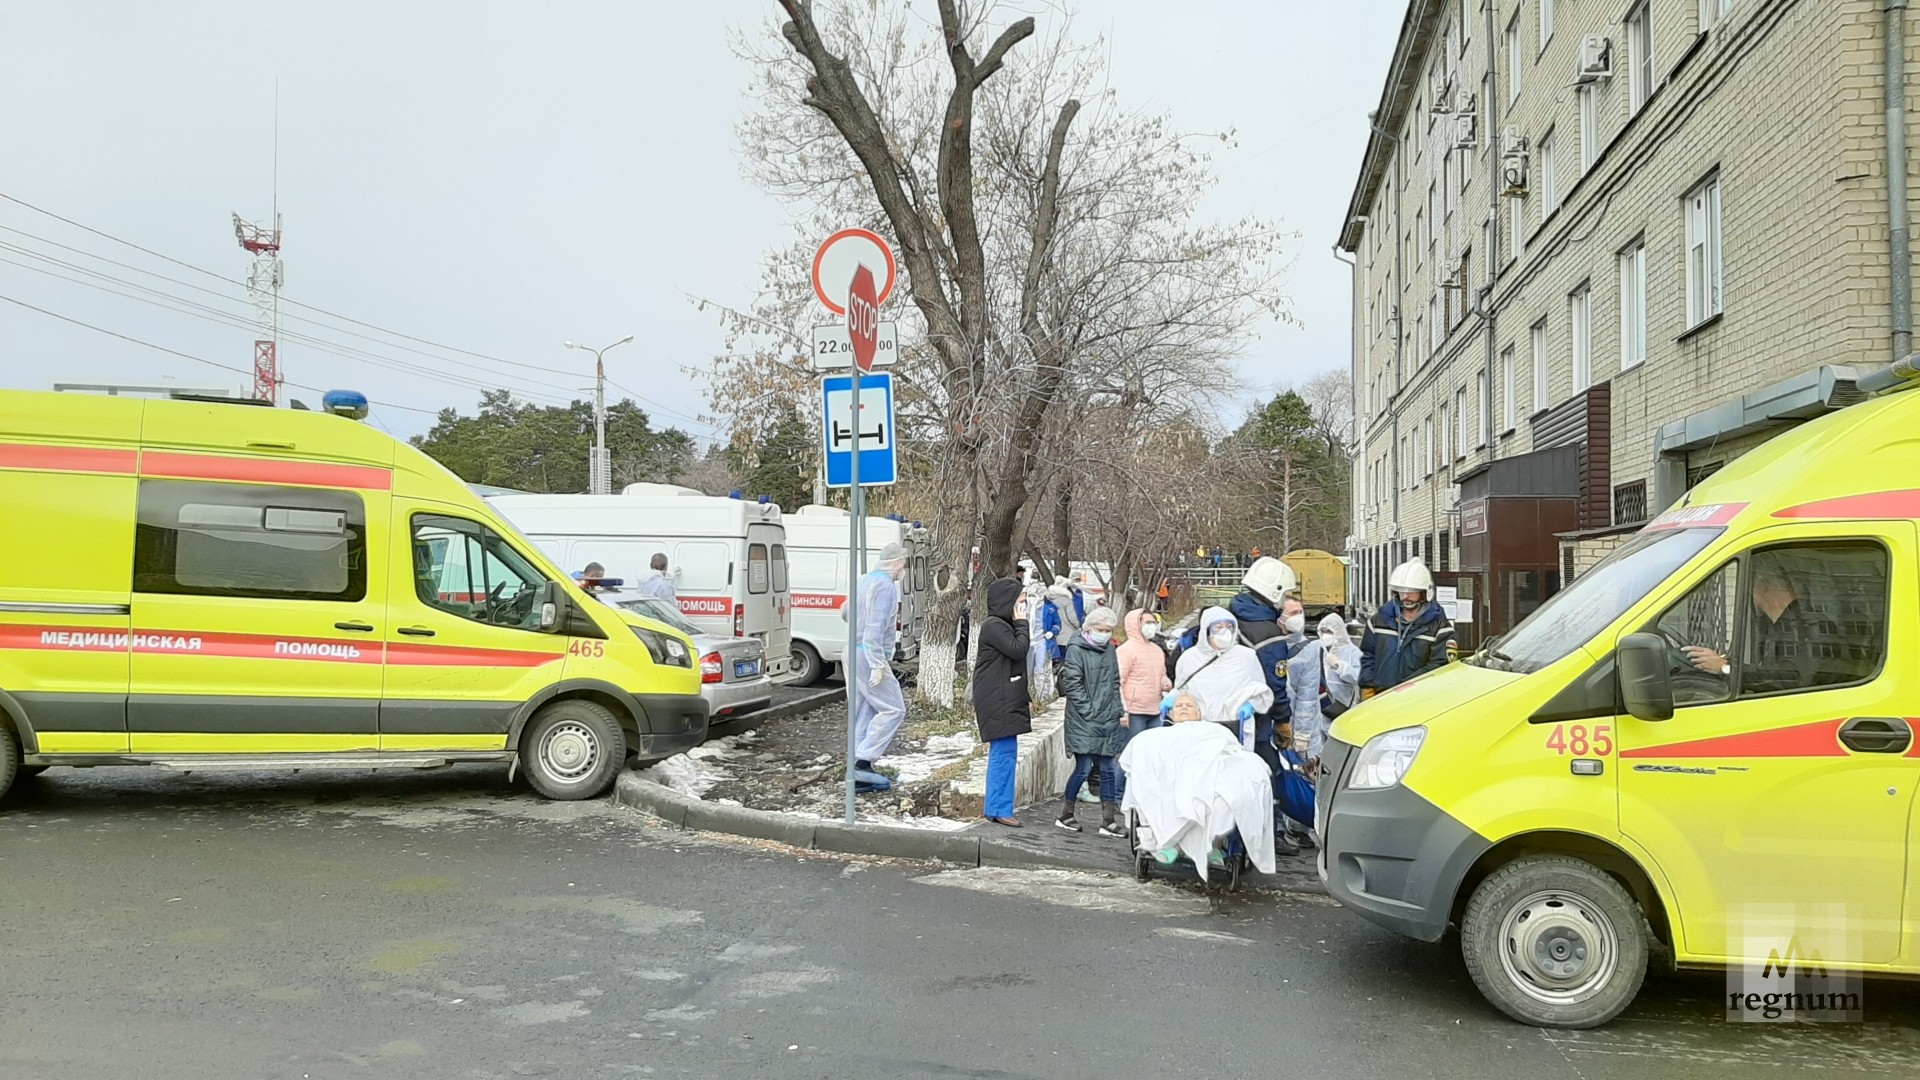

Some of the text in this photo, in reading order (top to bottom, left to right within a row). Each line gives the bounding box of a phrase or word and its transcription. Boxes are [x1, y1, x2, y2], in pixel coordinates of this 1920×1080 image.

[850, 291, 876, 342] STOP
[790, 596, 833, 607] ЦИНСКАЯ
[41, 631, 361, 659] МЕДИЦИНСКАЯ ПОМОЩЬ
[568, 639, 604, 659] 465
[1546, 724, 1613, 756] 485
